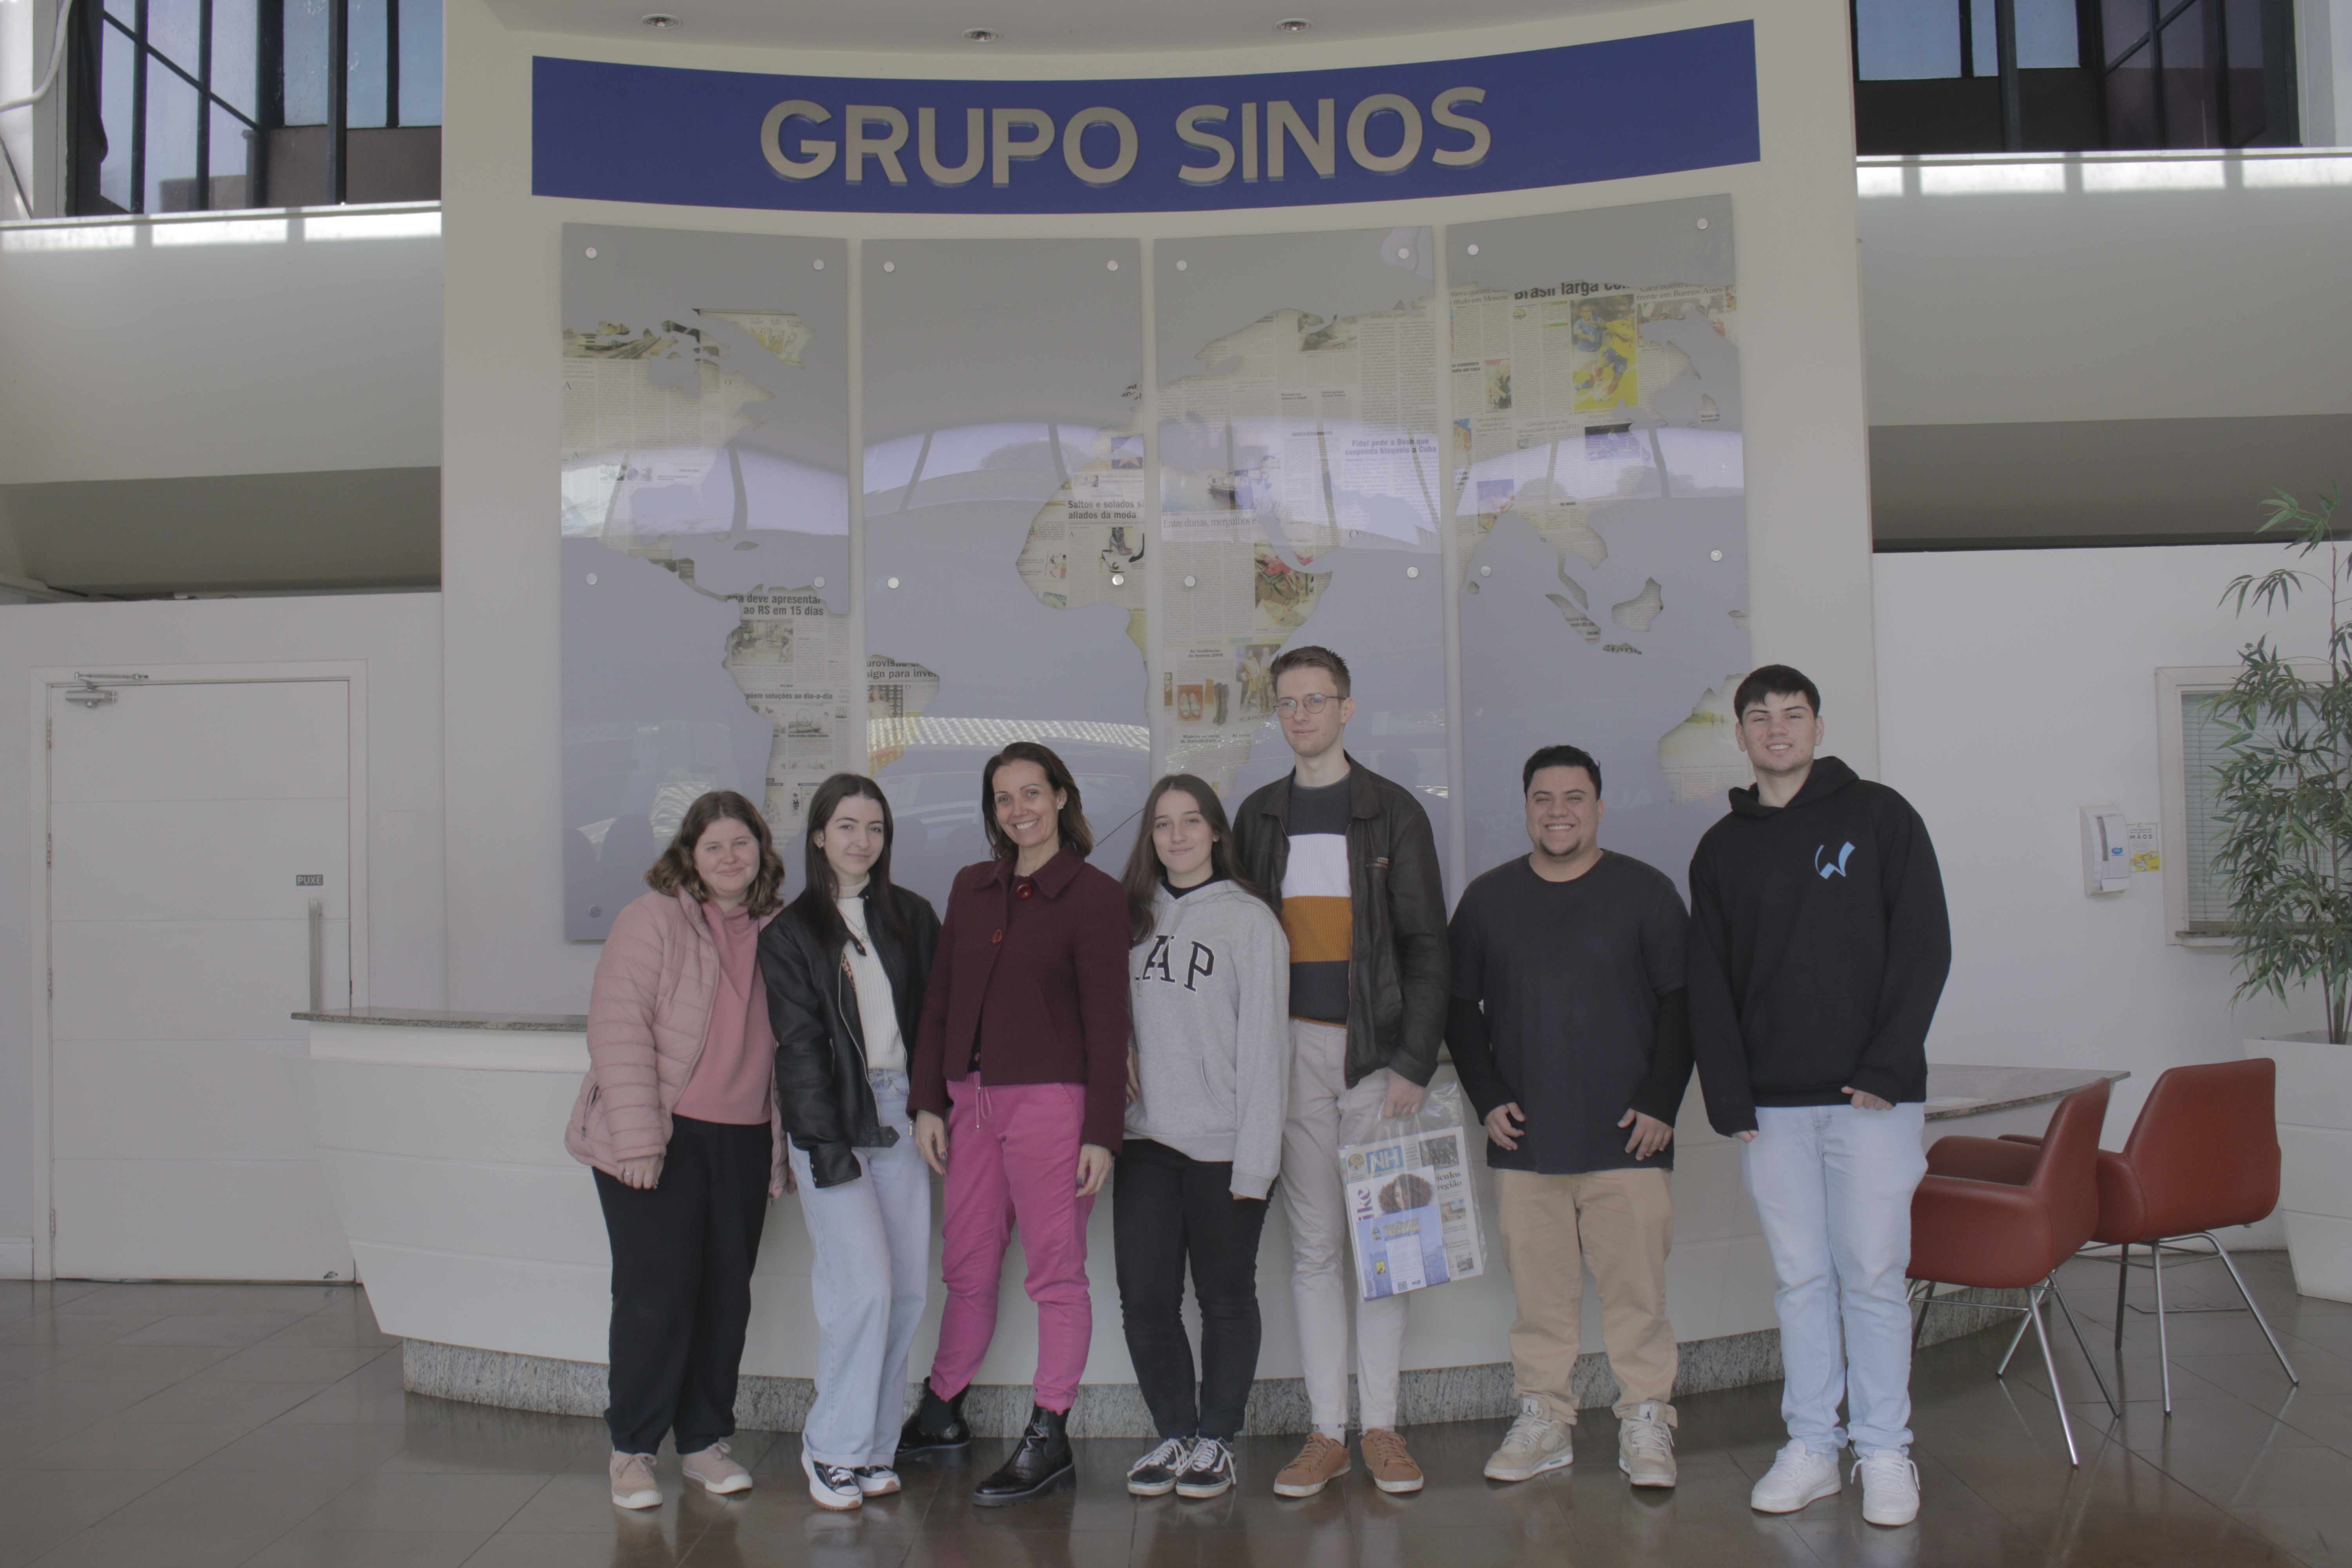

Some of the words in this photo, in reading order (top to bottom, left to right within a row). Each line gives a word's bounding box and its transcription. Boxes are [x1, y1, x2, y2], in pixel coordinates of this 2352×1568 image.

[760, 98, 1139, 188] GRUPO
[1176, 86, 1491, 183] SINOS
[1561, 282, 1599, 296] larga
[1637, 292, 1658, 301] frente
[1371, 439, 1388, 448] pede
[1345, 448, 1378, 456] suspenda
[1068, 500, 1093, 508] Saltos
[1103, 500, 1134, 508] solados
[1068, 511, 1098, 519] aliados
[1114, 511, 1136, 519] moda
[1163, 519, 1183, 528] Entre
[1184, 518, 1209, 528] dunas,
[1210, 516, 1251, 528] mergulhos
[747, 594, 769, 603] deve
[772, 594, 820, 605] apresentar
[758, 606, 770, 615] RS
[773, 607, 787, 615] em
[791, 606, 802, 615] 15
[804, 606, 824, 616] dias
[867, 670, 885, 679] sign
[889, 671, 910, 679] para
[765, 692, 792, 701] soluções
[1129, 935, 1215, 993] AP
[1368, 1149, 1400, 1175] NH
[1437, 1180, 1462, 1191] região
